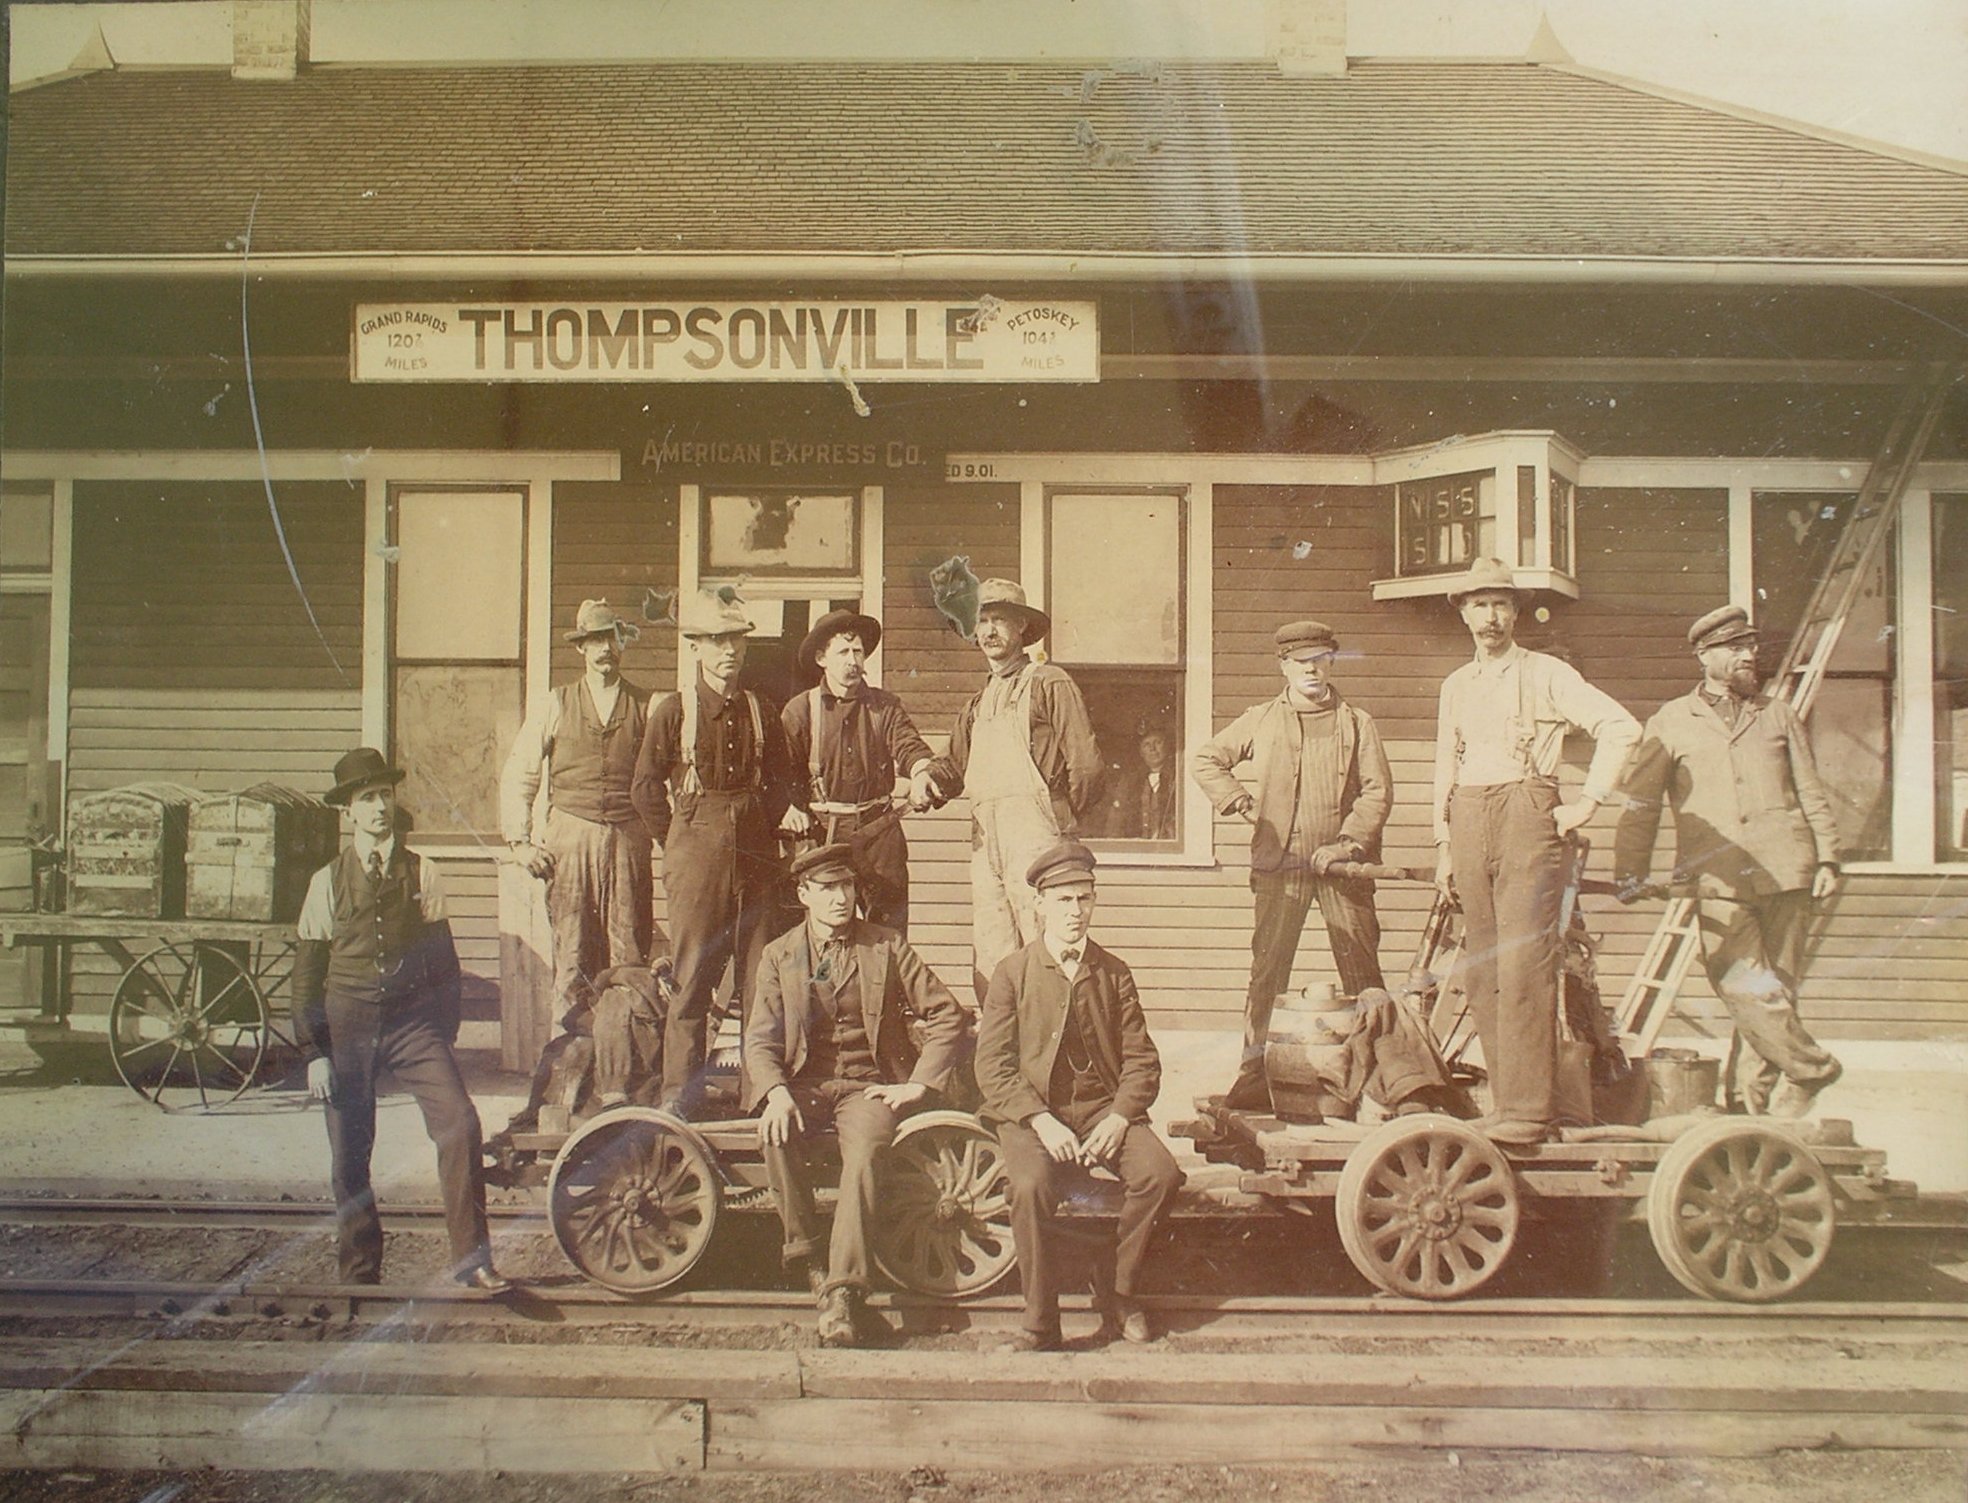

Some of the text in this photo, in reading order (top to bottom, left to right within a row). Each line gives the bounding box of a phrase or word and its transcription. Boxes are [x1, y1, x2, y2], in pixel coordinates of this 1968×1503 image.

[361, 310, 448, 335] GRAND RAPIDS
[1007, 307, 1080, 331] PETOSKEY
[458, 308, 984, 370] THOMPSONVILLE
[385, 356, 428, 370] MILES
[1021, 355, 1065, 370] MILES
[641, 438, 761, 466] AMERICAN
[769, 439, 876, 466] EXPRESS
